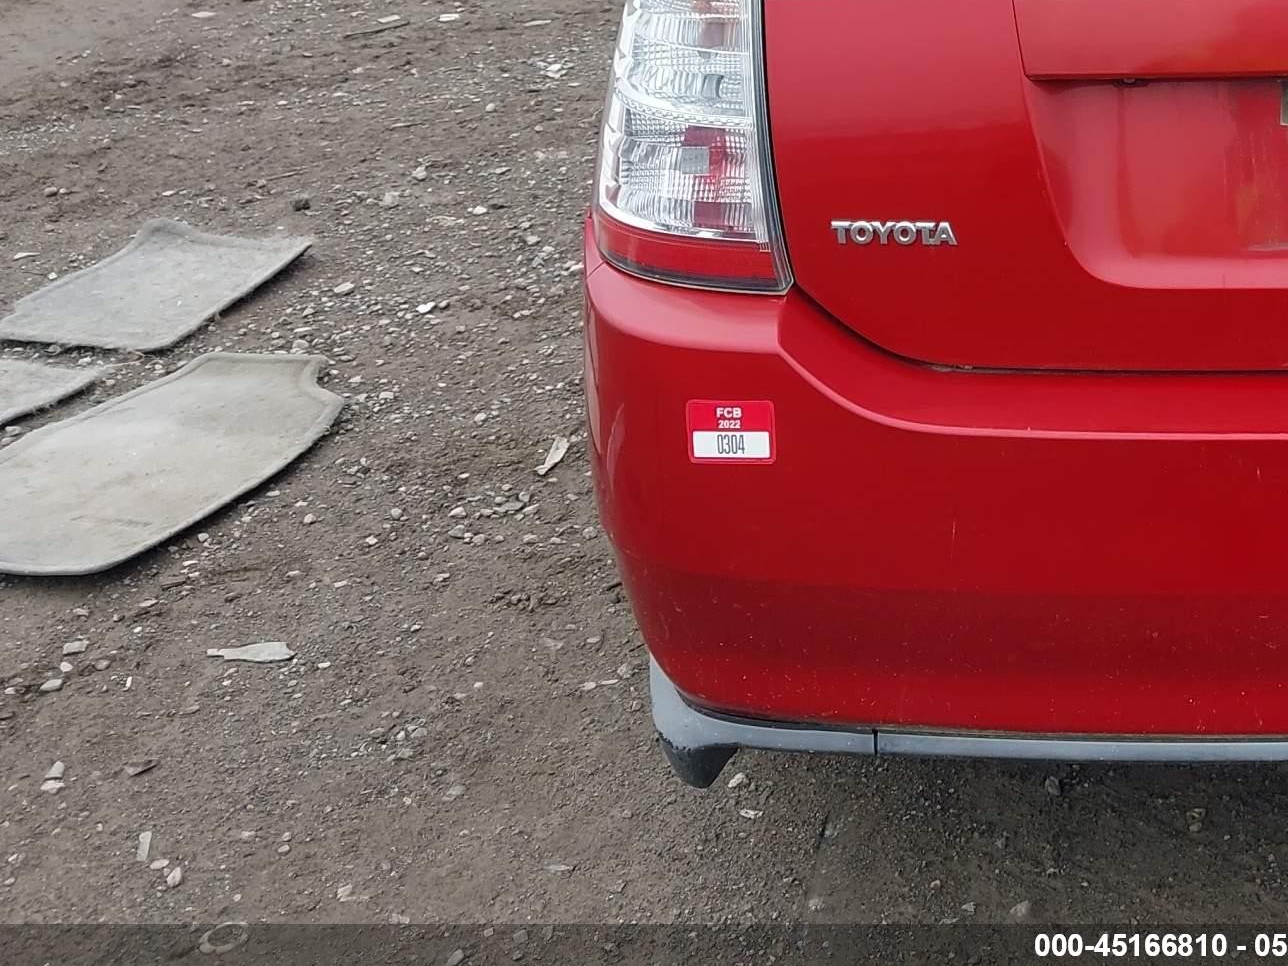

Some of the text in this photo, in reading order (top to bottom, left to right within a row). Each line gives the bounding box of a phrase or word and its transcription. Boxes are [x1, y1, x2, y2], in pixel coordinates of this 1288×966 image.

[830, 220, 958, 246] TOYOTA
[716, 407, 742, 418] FCB
[718, 420, 741, 429] 2022
[717, 434, 745, 455] 0304
